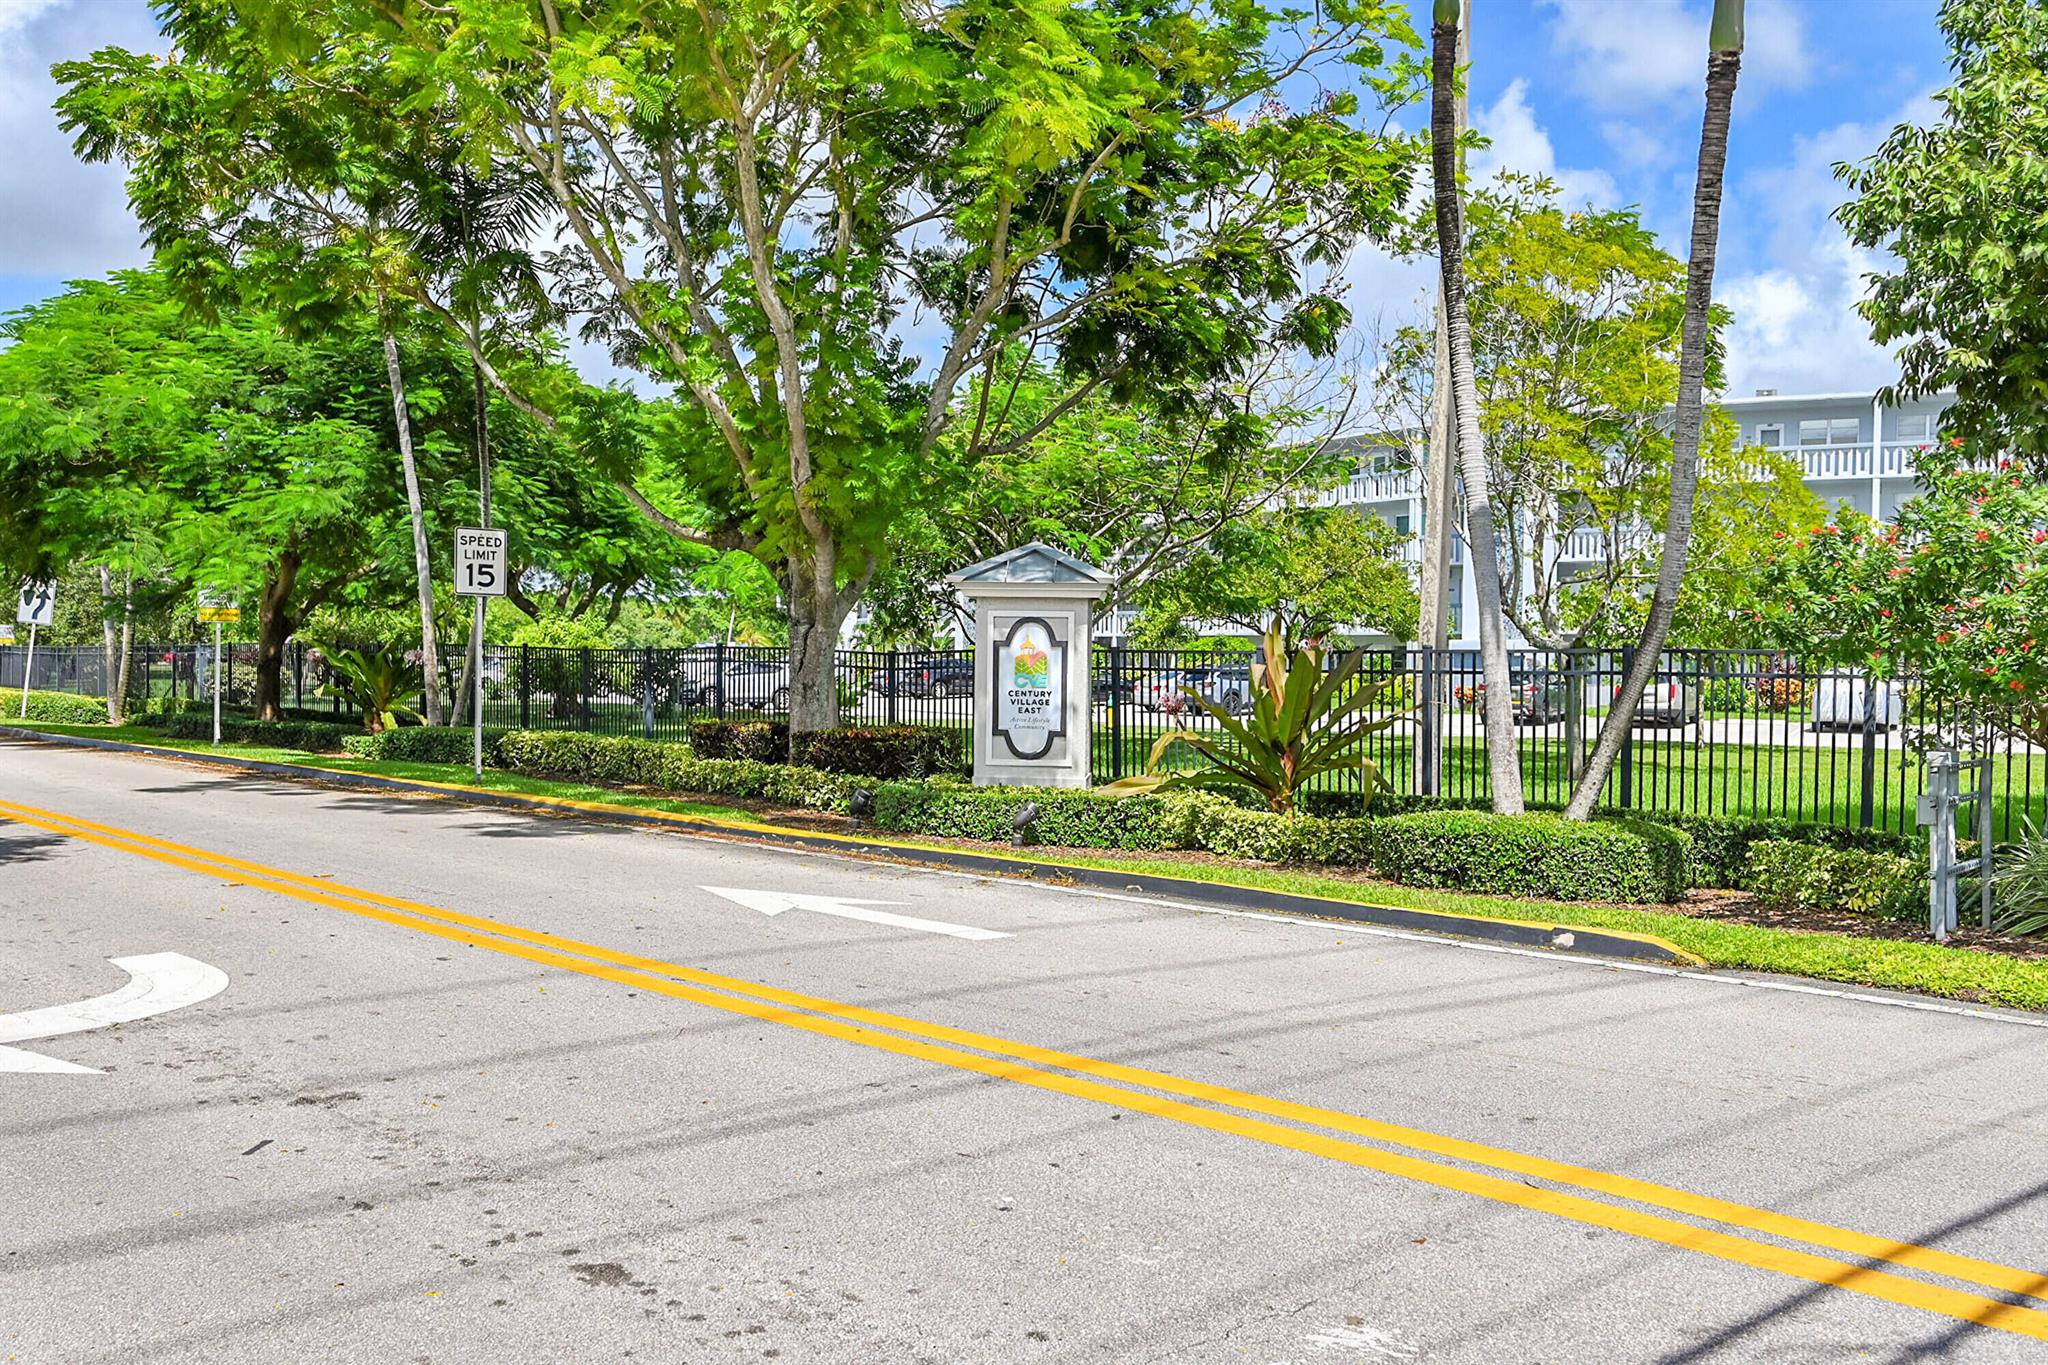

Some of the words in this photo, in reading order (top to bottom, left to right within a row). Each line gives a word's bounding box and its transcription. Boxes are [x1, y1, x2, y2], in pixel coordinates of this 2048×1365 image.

[460, 535, 502, 548] SPEED
[464, 549, 497, 560] LIMIT
[466, 563, 495, 587] 15
[1010, 698, 1050, 706] VILLAGE
[1018, 706, 1041, 714] EAST
